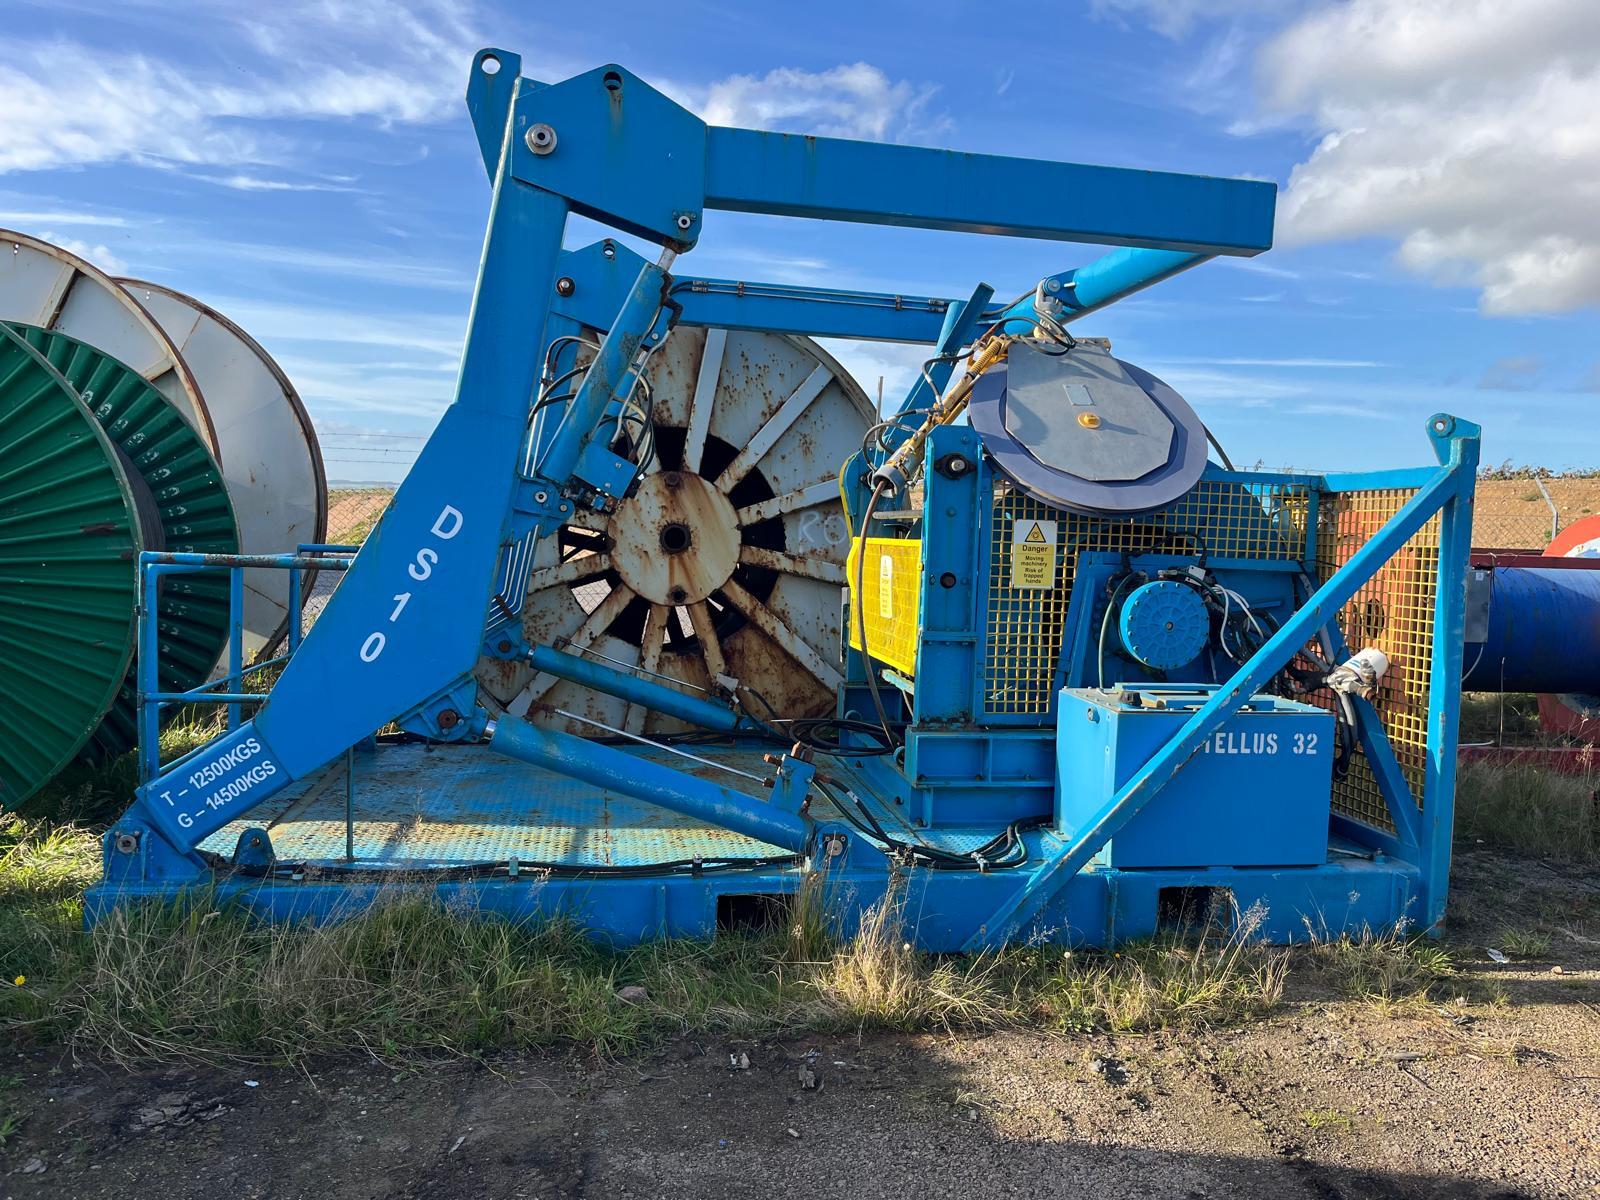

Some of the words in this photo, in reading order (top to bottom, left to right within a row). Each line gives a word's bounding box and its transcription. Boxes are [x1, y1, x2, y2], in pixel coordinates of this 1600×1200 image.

[1022, 545, 1049, 553] Danger
[1293, 733, 1318, 755] 32
[160, 790, 174, 806] T
[189, 737, 261, 790] 12500KGS
[177, 812, 193, 828] G
[206, 760, 276, 810] 14500KGS
